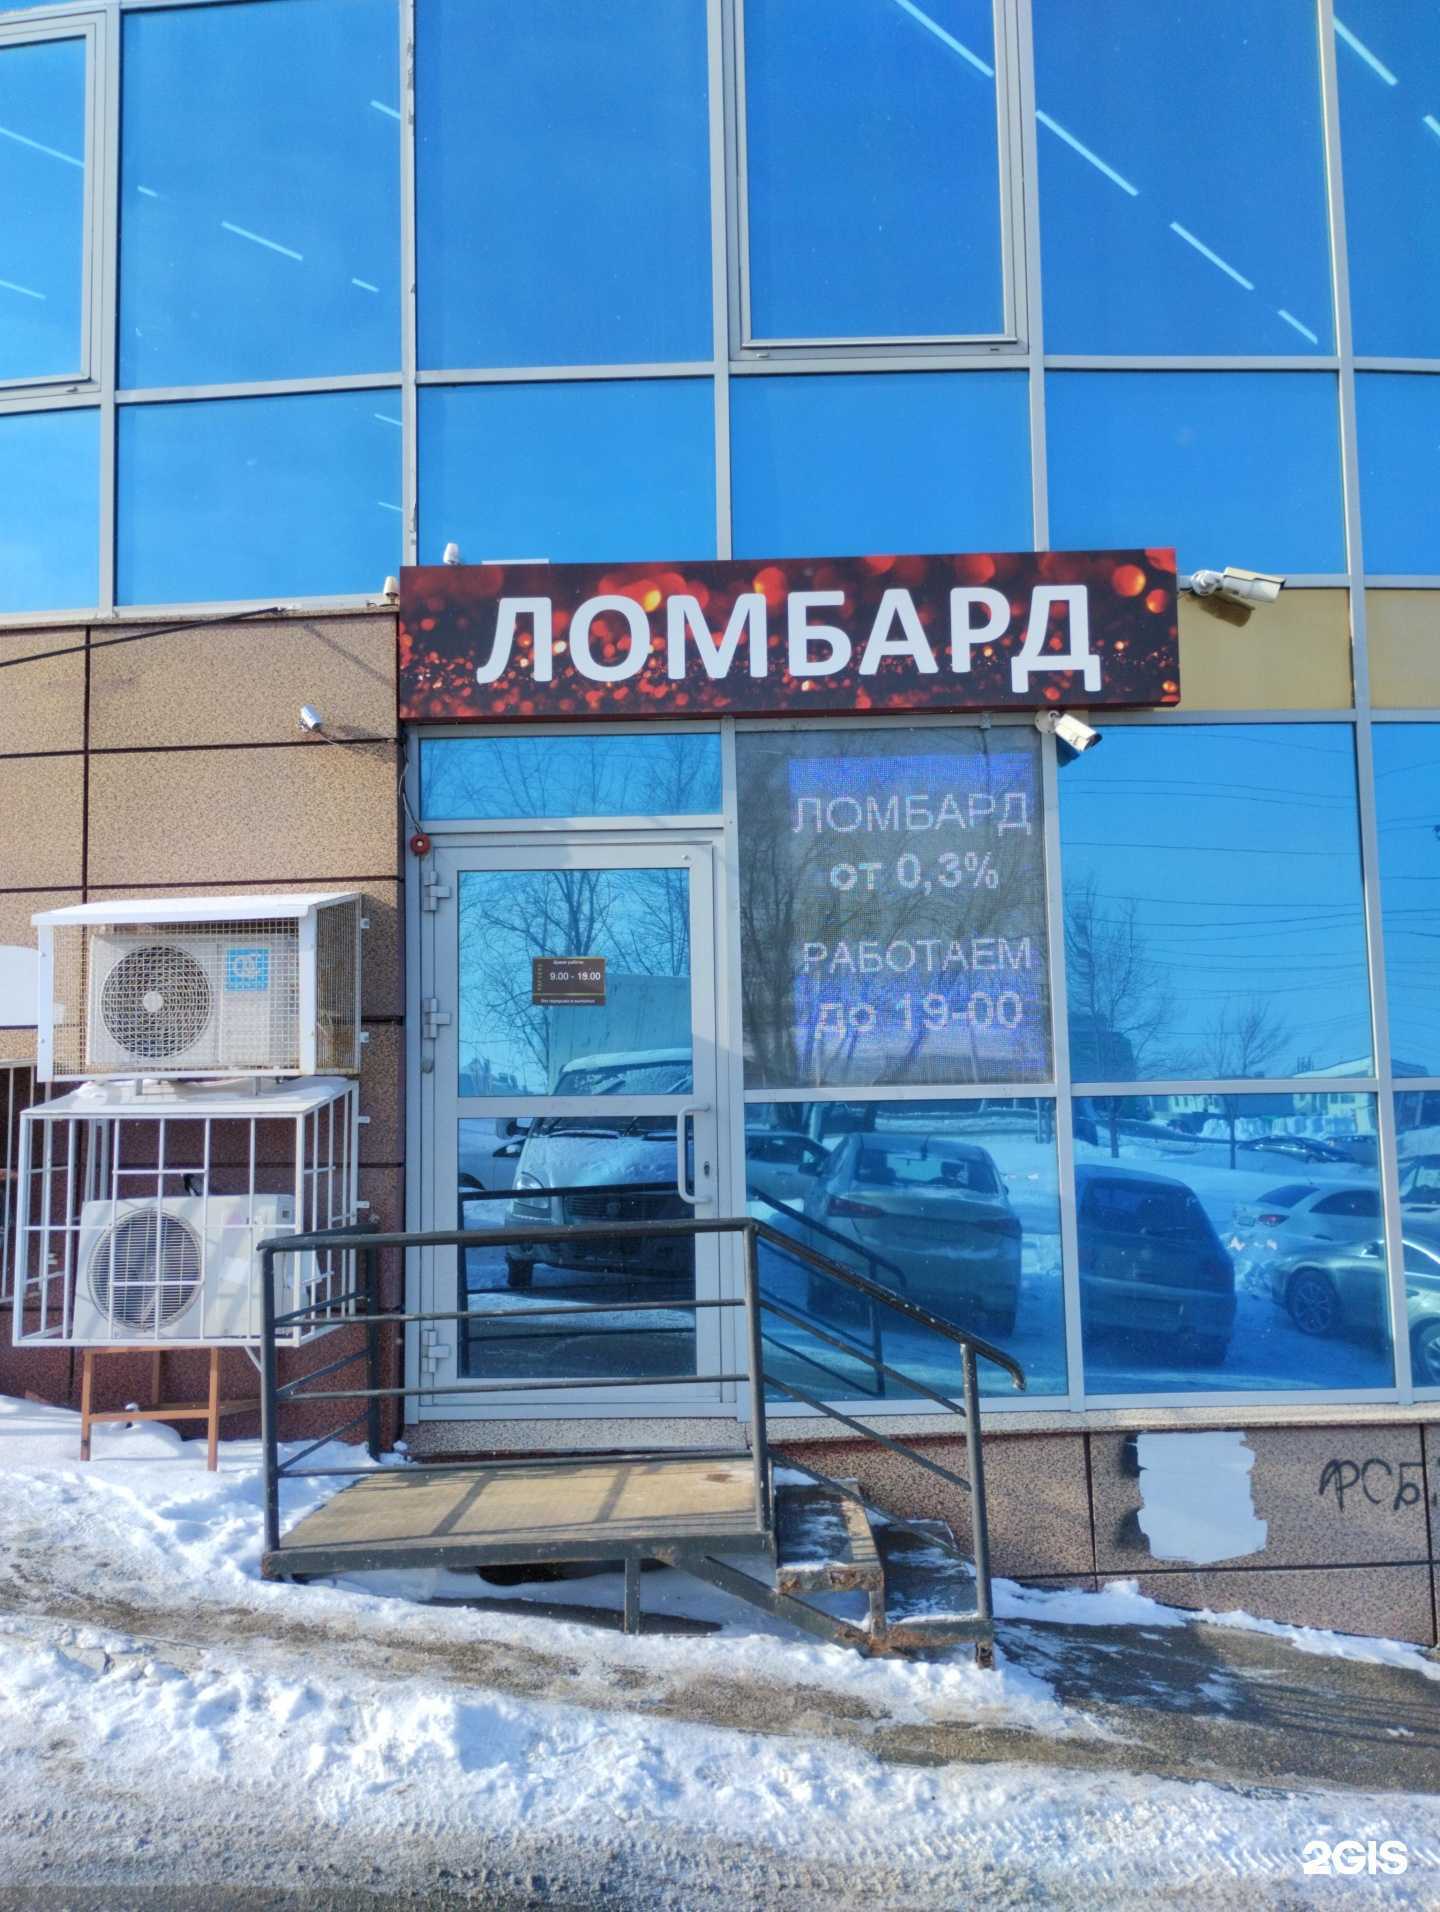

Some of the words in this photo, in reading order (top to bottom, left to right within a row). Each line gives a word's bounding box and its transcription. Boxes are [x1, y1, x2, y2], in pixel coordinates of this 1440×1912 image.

[476, 584, 1102, 694] ЛОМБАРД
[791, 791, 1033, 837] ЛОМБАРД
[896, 850, 999, 896] 0,3%
[549, 971, 569, 981] 9.00
[801, 937, 1032, 974] РАБОТАЕМ
[895, 991, 1024, 1032] 19-00
